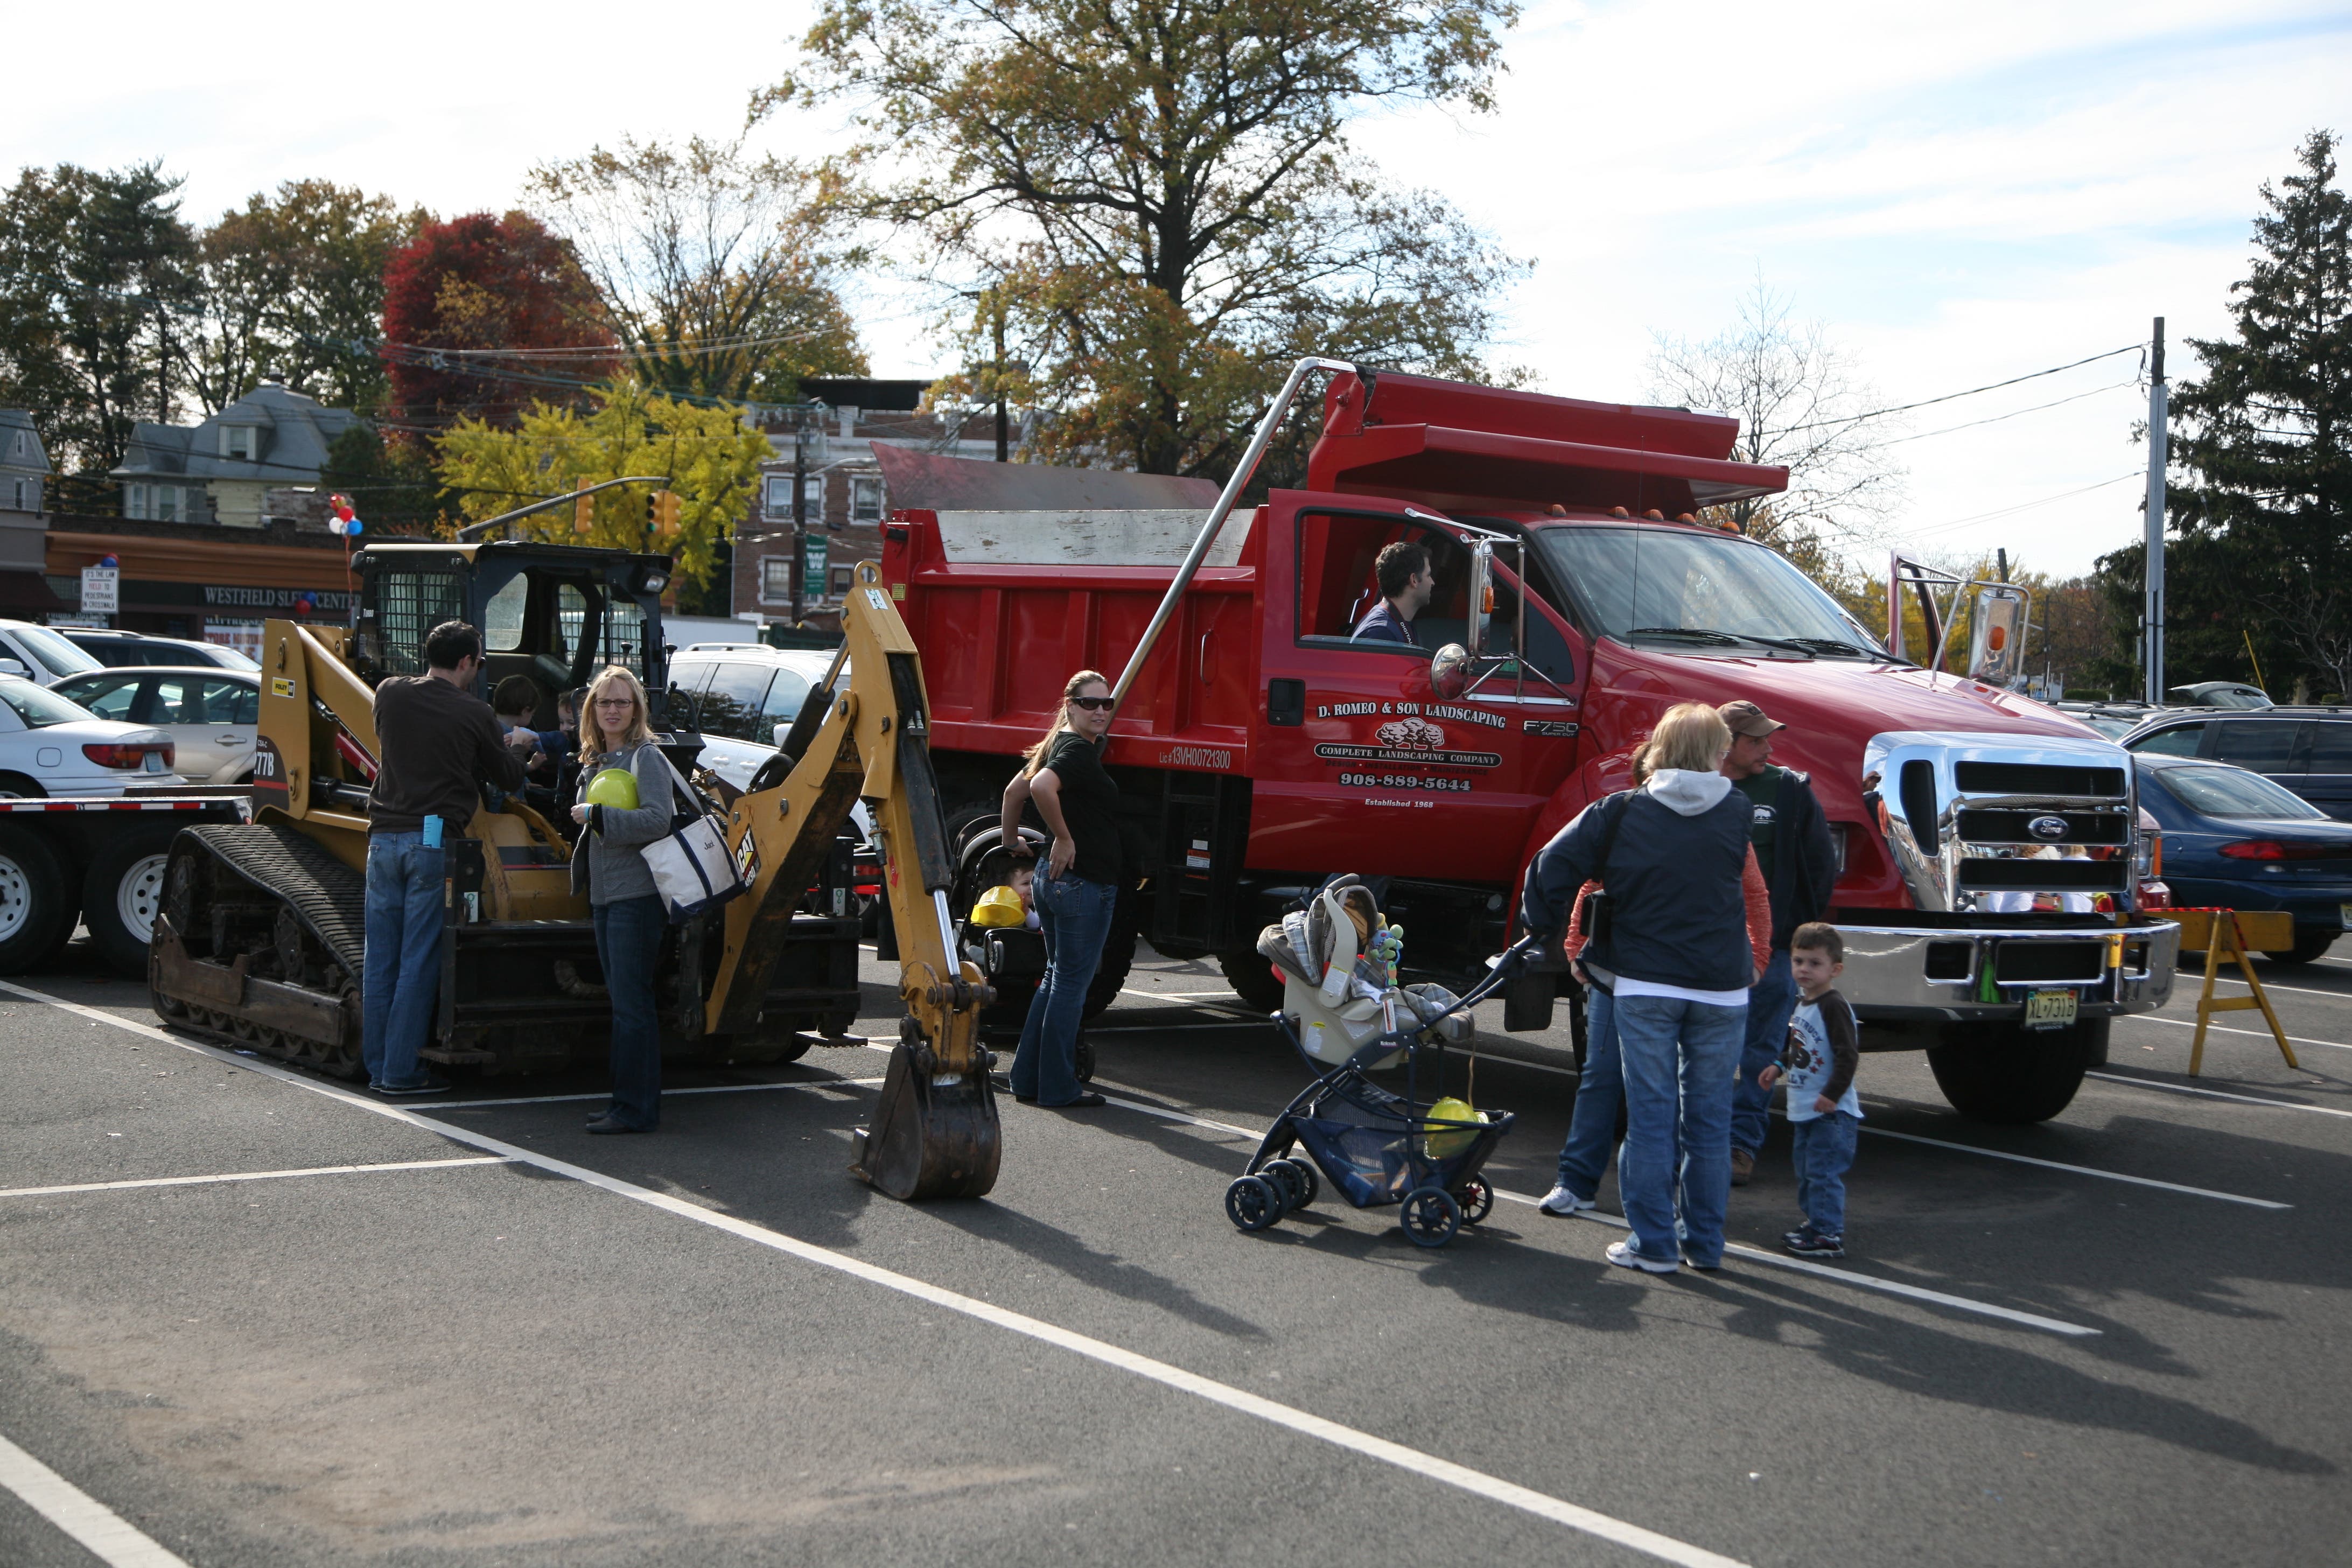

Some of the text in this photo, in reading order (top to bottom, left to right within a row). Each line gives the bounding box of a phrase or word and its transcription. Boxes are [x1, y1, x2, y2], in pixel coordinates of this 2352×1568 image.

[205, 586, 275, 606] WESTFIELD
[316, 592, 362, 610] CENTER
[1318, 702, 1506, 729] D. ROMEO & SON LANDSCAPING
[254, 752, 275, 777] 77B
[1159, 752, 1167, 764] Lic
[1320, 746, 1496, 765] COMPLETE LANDSCAPING COMPANY
[1325, 759, 1489, 776] DESIGN INSTALLATION MAINTENANCE
[1340, 773, 1471, 792] 908-889-5644
[1364, 799, 1434, 808] Established 1968
[737, 828, 754, 873] CAT
